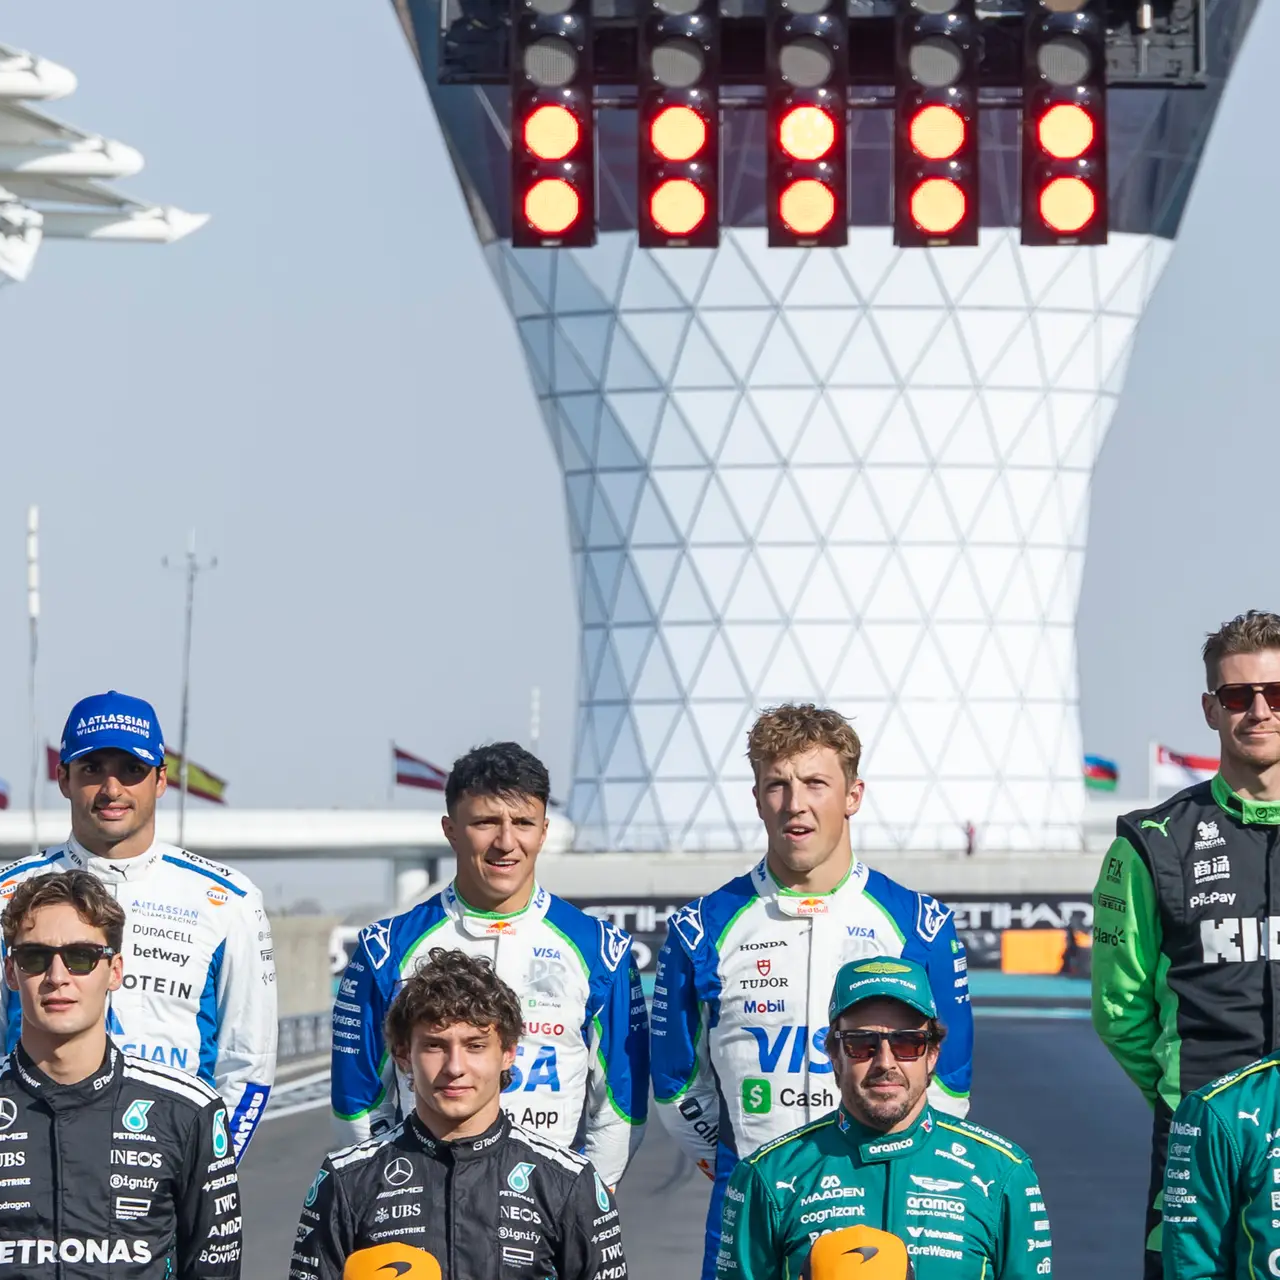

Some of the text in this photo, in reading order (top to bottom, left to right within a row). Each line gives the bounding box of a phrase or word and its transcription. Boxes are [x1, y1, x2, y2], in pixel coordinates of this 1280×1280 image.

[76, 714, 150, 739] ATLASSIAN WILLIAMS RACING
[1194, 837, 1225, 848] SINGHA
[1108, 858, 1123, 878] FIX
[1196, 873, 1230, 884] sensetime
[206, 890, 228, 901] Gulf
[1190, 892, 1236, 908] PicPay
[133, 924, 193, 943] DURACELL
[846, 926, 875, 939] VISA
[1094, 927, 1118, 946] Claro
[740, 940, 788, 951] HONDA
[133, 944, 190, 967] betway
[533, 948, 561, 960] VISA
[740, 977, 788, 989] TUDOR
[849, 978, 881, 990] FORMULA
[899, 980, 917, 989] TEAM
[744, 999, 785, 1014] Mobil
[740, 1026, 834, 1073] VIS
[780, 1089, 833, 1107] Cash
[521, 1109, 558, 1128] App
[113, 1132, 156, 1142] PETRONAS
[960, 1122, 1012, 1149] coinbase
[869, 1138, 913, 1154] aramco
[110, 1150, 162, 1168] INEOS
[208, 1156, 234, 1173] PETRONAS
[214, 1193, 236, 1215] IWC
[500, 1191, 534, 1204] PETRONAS
[801, 1188, 864, 1206] MAADEN
[907, 1197, 965, 1213] aramco
[392, 1204, 421, 1218] UBS
[593, 1209, 618, 1227] PETRONAS
[801, 1205, 865, 1224] cognizant
[373, 1226, 426, 1238] CROWDSTRIKE
[923, 1229, 964, 1242] Valvoline
[199, 1249, 240, 1264] BONVOY
[601, 1242, 623, 1263] IWC
[907, 1244, 962, 1259] CoreWeave
